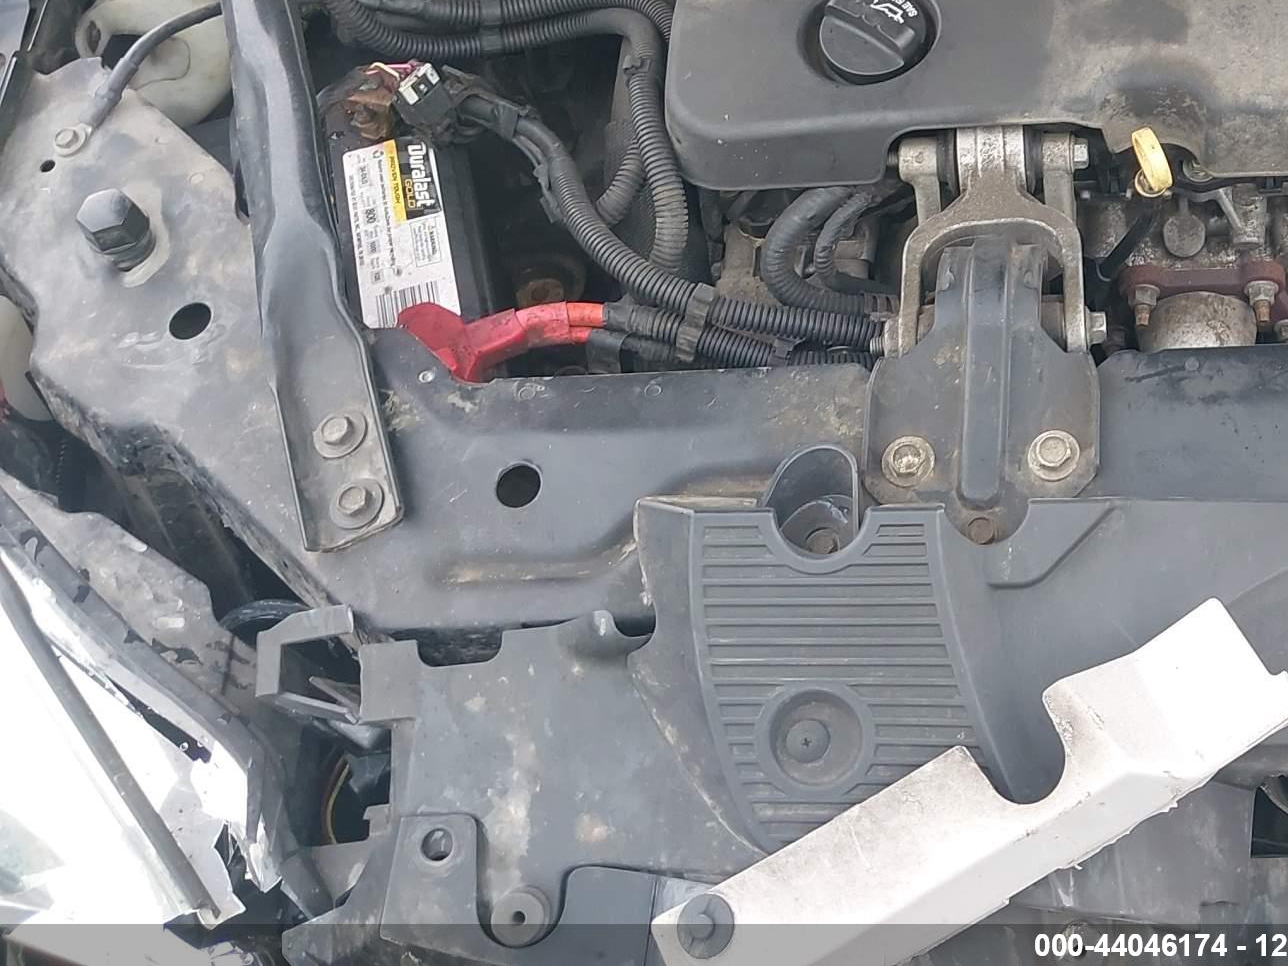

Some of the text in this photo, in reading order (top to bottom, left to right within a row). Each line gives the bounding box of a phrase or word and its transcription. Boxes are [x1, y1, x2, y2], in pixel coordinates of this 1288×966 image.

[901, 1, 918, 17] SAE
[388, 155, 400, 203] PROVEN TOUGH
[407, 141, 435, 208] Duralast
[404, 178, 416, 208] GOLD
[365, 208, 375, 223] 800
